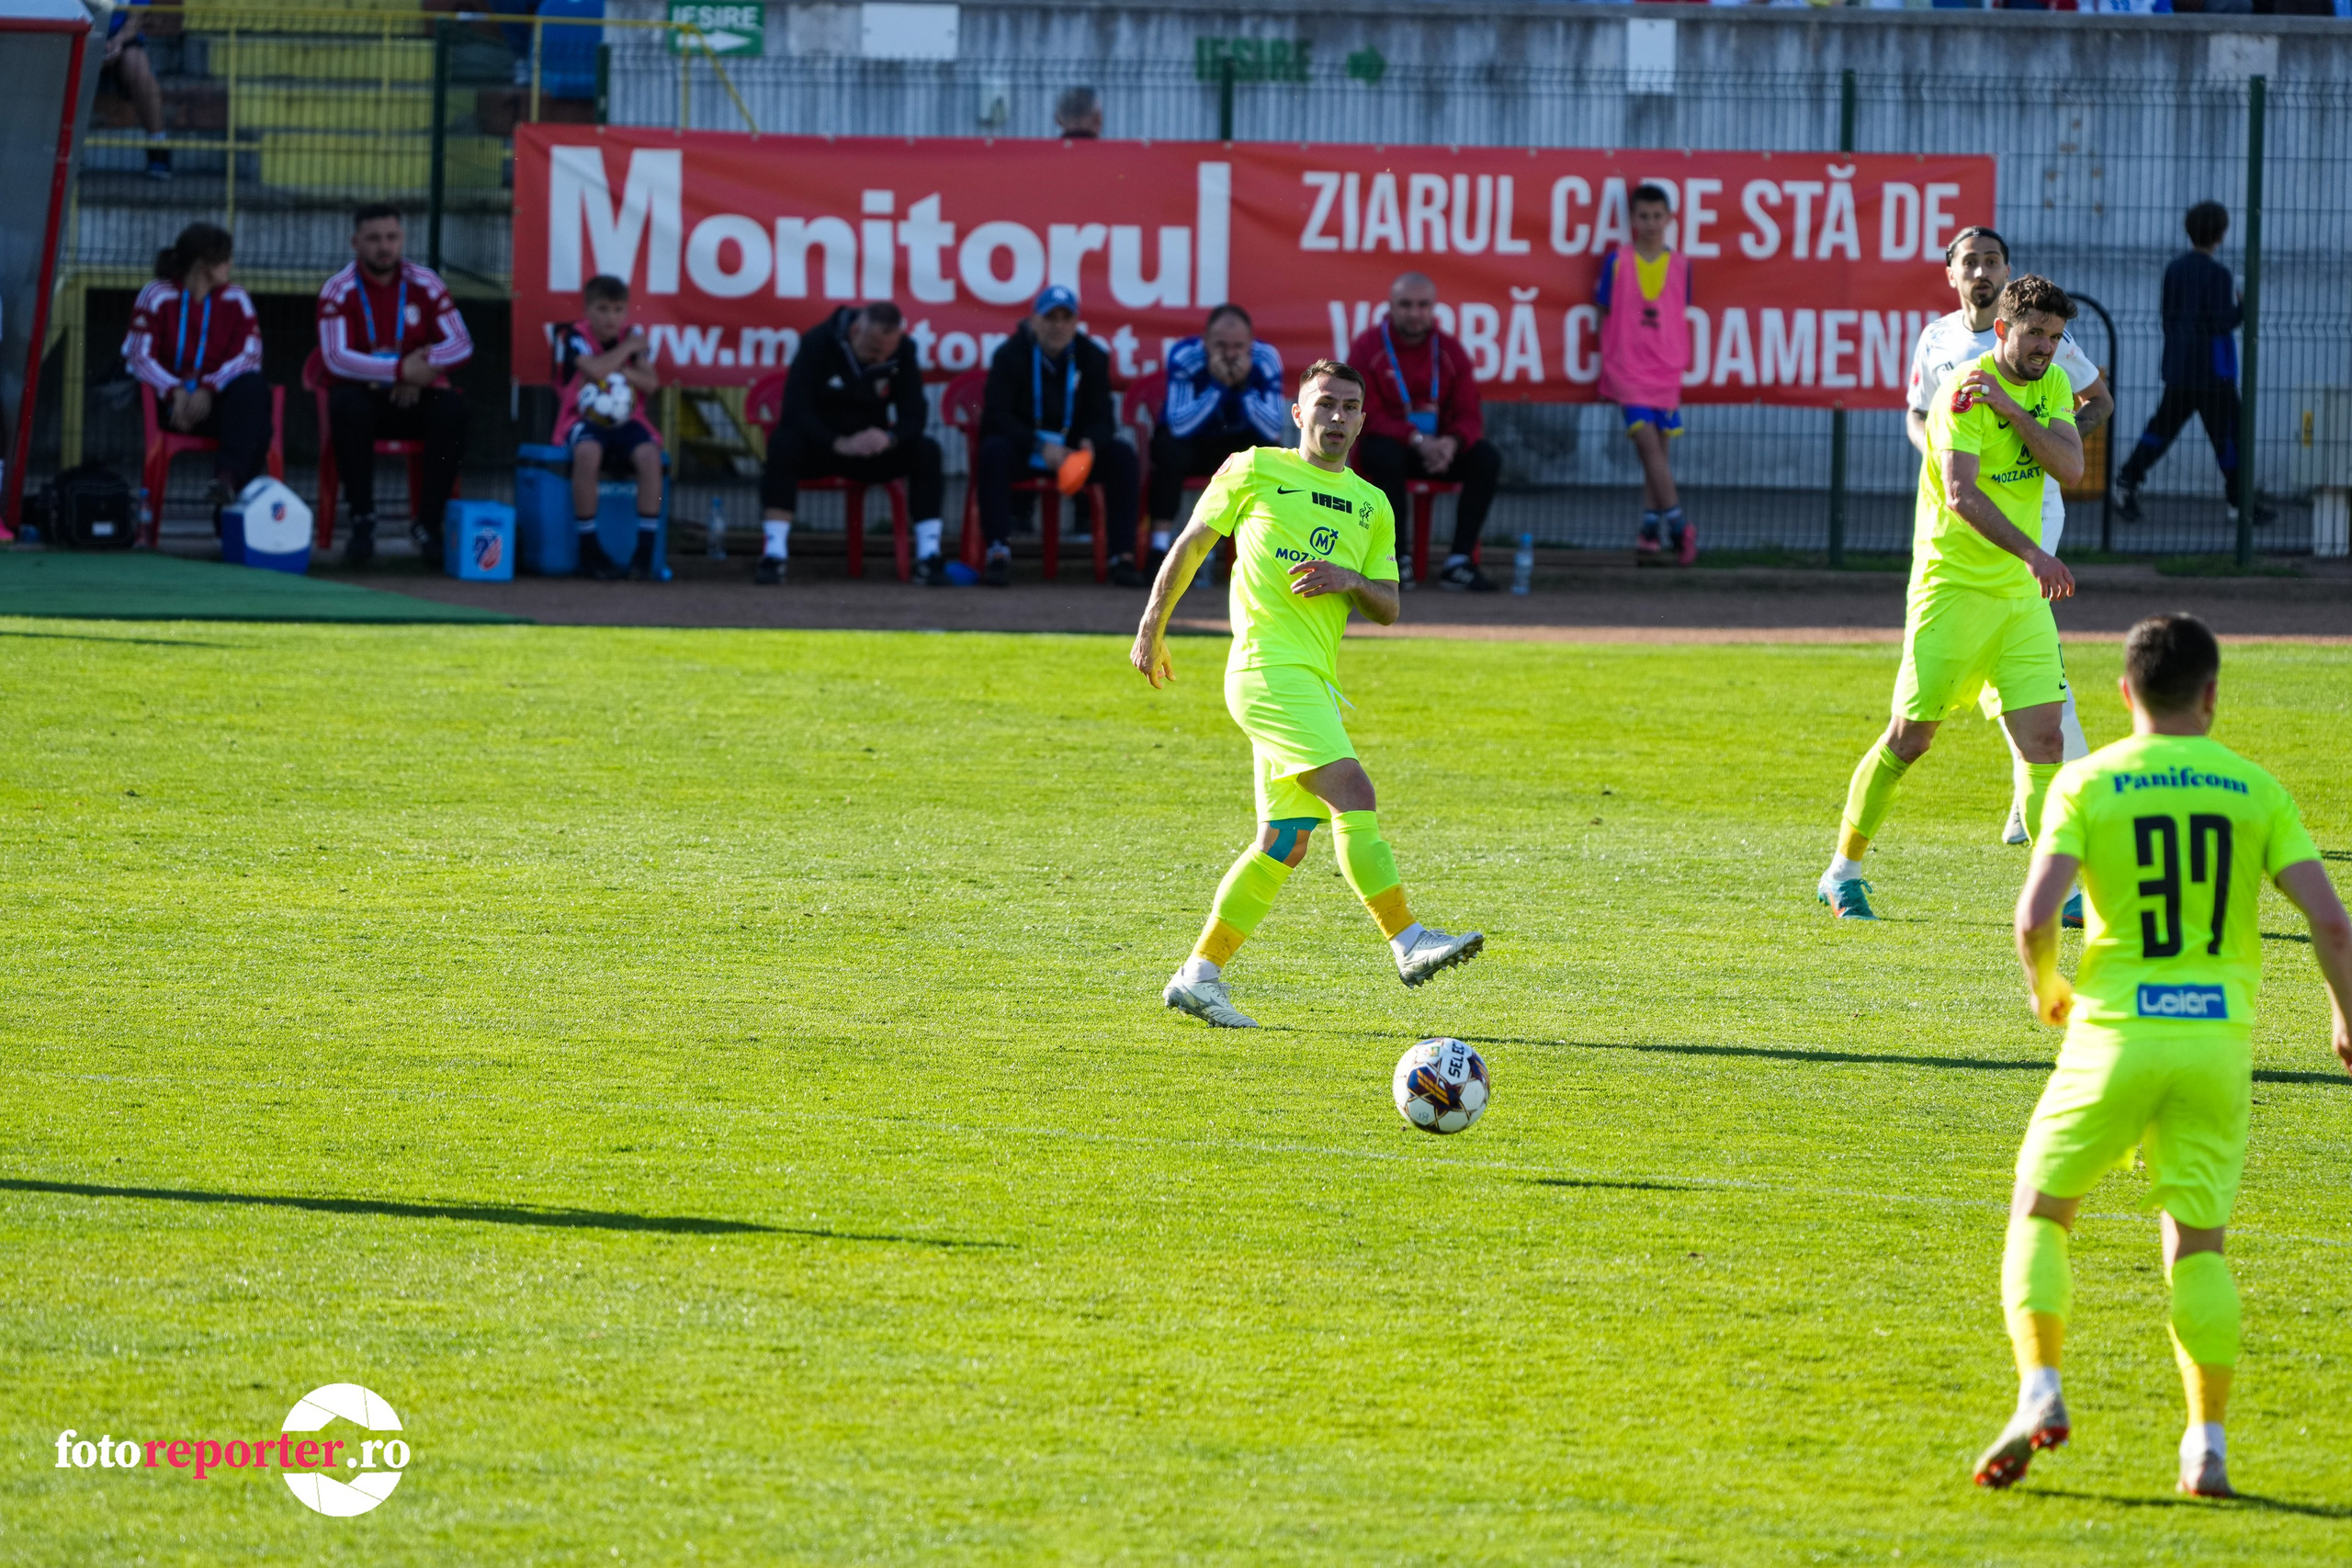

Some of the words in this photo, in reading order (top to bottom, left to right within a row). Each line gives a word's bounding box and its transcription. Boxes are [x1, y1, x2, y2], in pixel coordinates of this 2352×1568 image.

[548, 146, 1231, 308] Monitorul
[1300, 171, 1531, 255] ZIARUL
[1738, 164, 1862, 262] STĂ
[1880, 182, 1960, 263] DE
[1328, 286, 1544, 383] VBĂ
[1680, 304, 1941, 389] OAMENI
[1991, 466, 2041, 483] MOZZART
[2113, 766, 2249, 795] Panifcom
[2133, 813, 2233, 958] 37
[1449, 1041, 1464, 1078] SELEC
